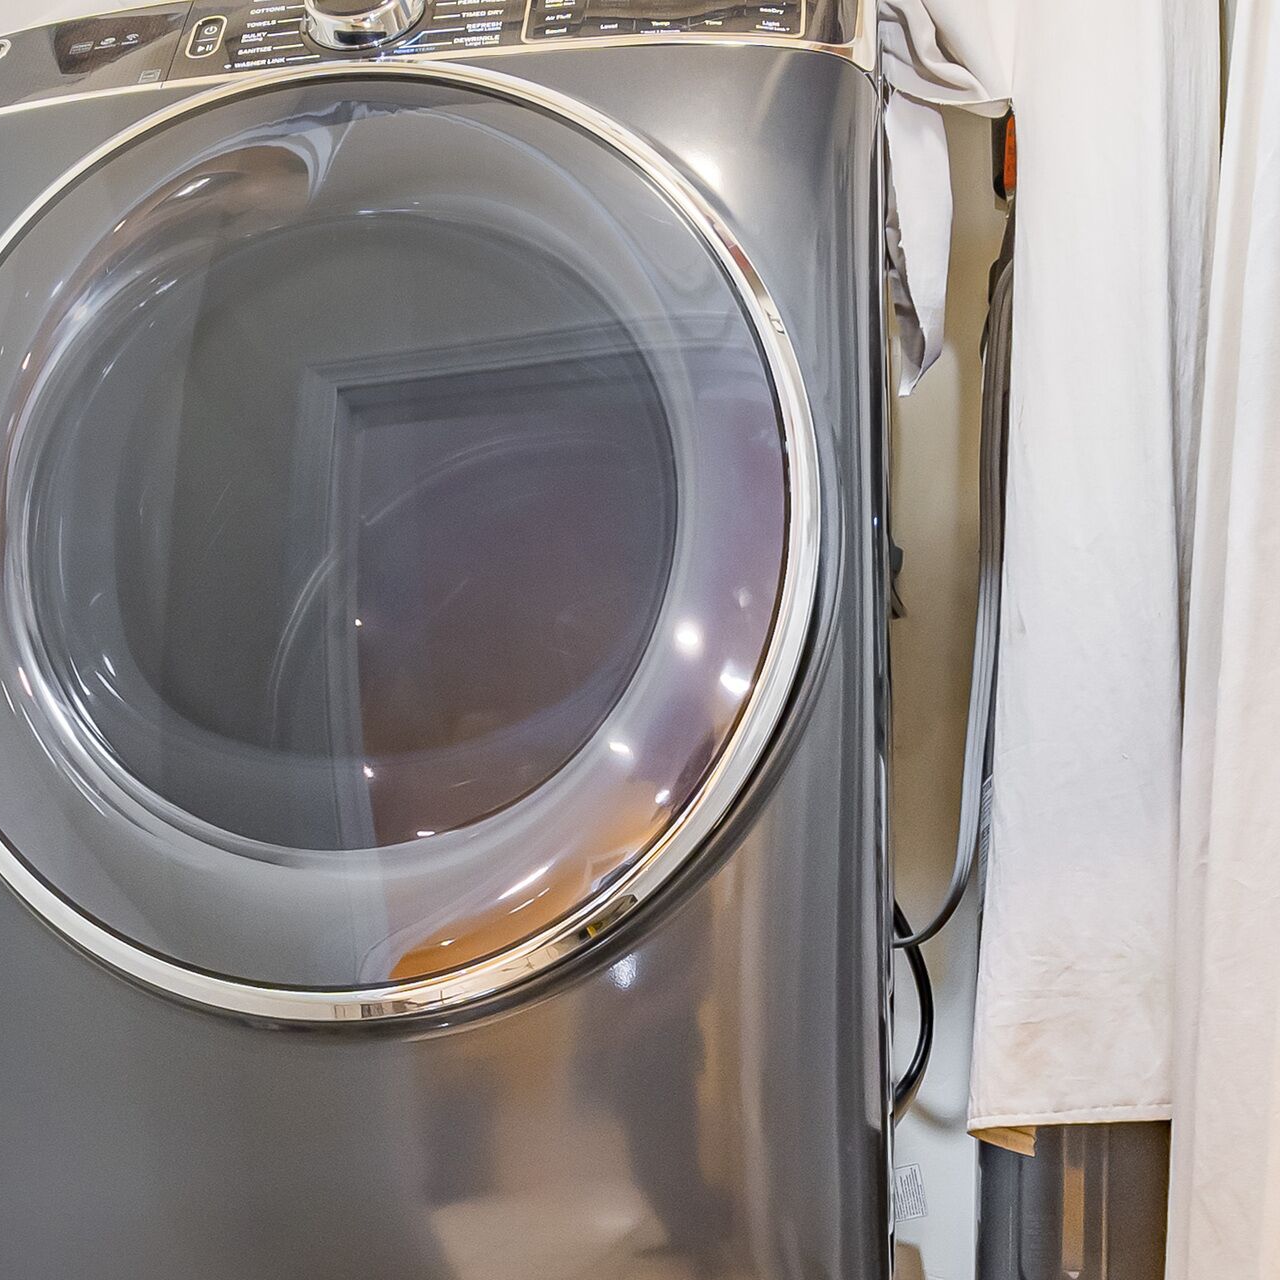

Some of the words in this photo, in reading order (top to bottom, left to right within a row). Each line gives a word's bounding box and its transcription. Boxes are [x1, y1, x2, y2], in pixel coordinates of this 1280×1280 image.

[250, 6, 287, 15] COTTONS
[487, 9, 505, 17] DRY
[246, 20, 277, 28] TOWELS
[466, 21, 503, 30] REFRESH
[242, 31, 268, 40] BULKY
[453, 34, 501, 44] DEWRINKLE
[238, 46, 273, 56] SANITIZE
[234, 59, 267, 68] WASHER
[267, 57, 286, 65] LINK
